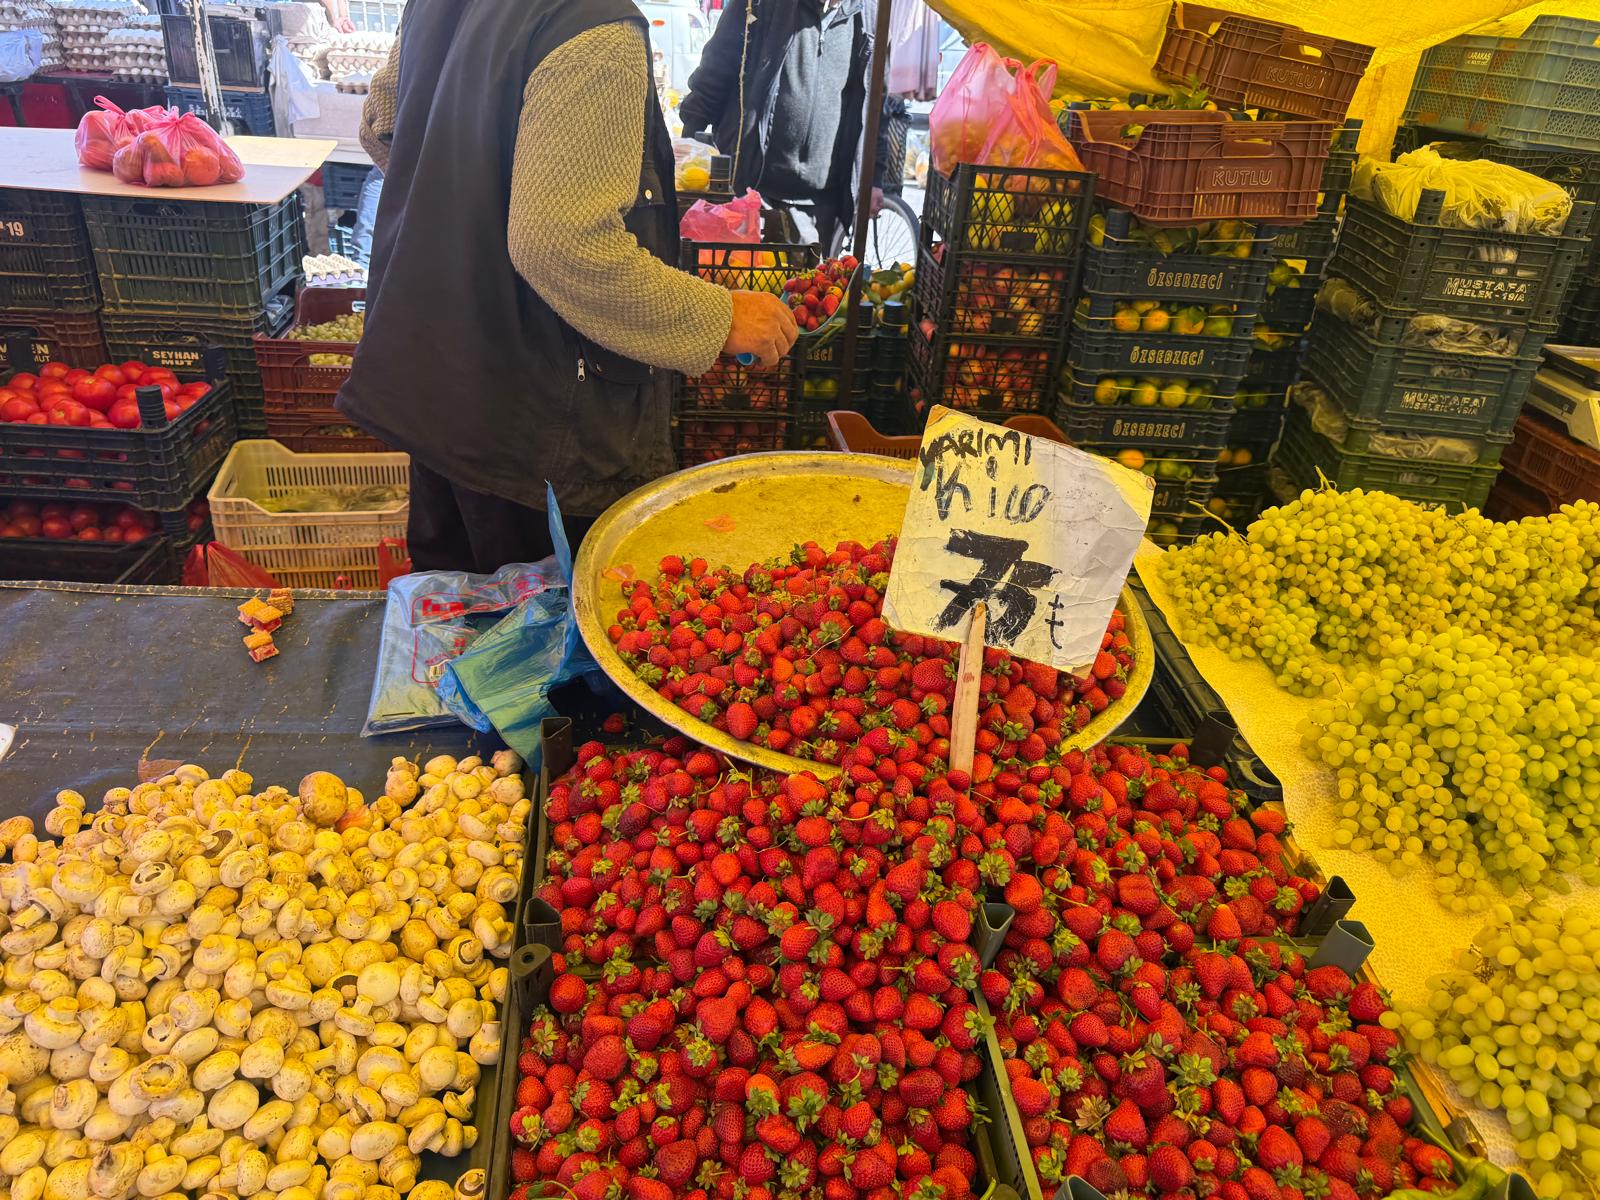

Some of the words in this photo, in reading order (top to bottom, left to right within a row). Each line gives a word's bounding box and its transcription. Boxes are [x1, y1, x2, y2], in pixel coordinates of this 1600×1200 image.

[1212, 169, 1272, 186] KUTLU
[1442, 277, 1528, 294] MUSTAFA
[152, 350, 199, 360] SEYHAN
